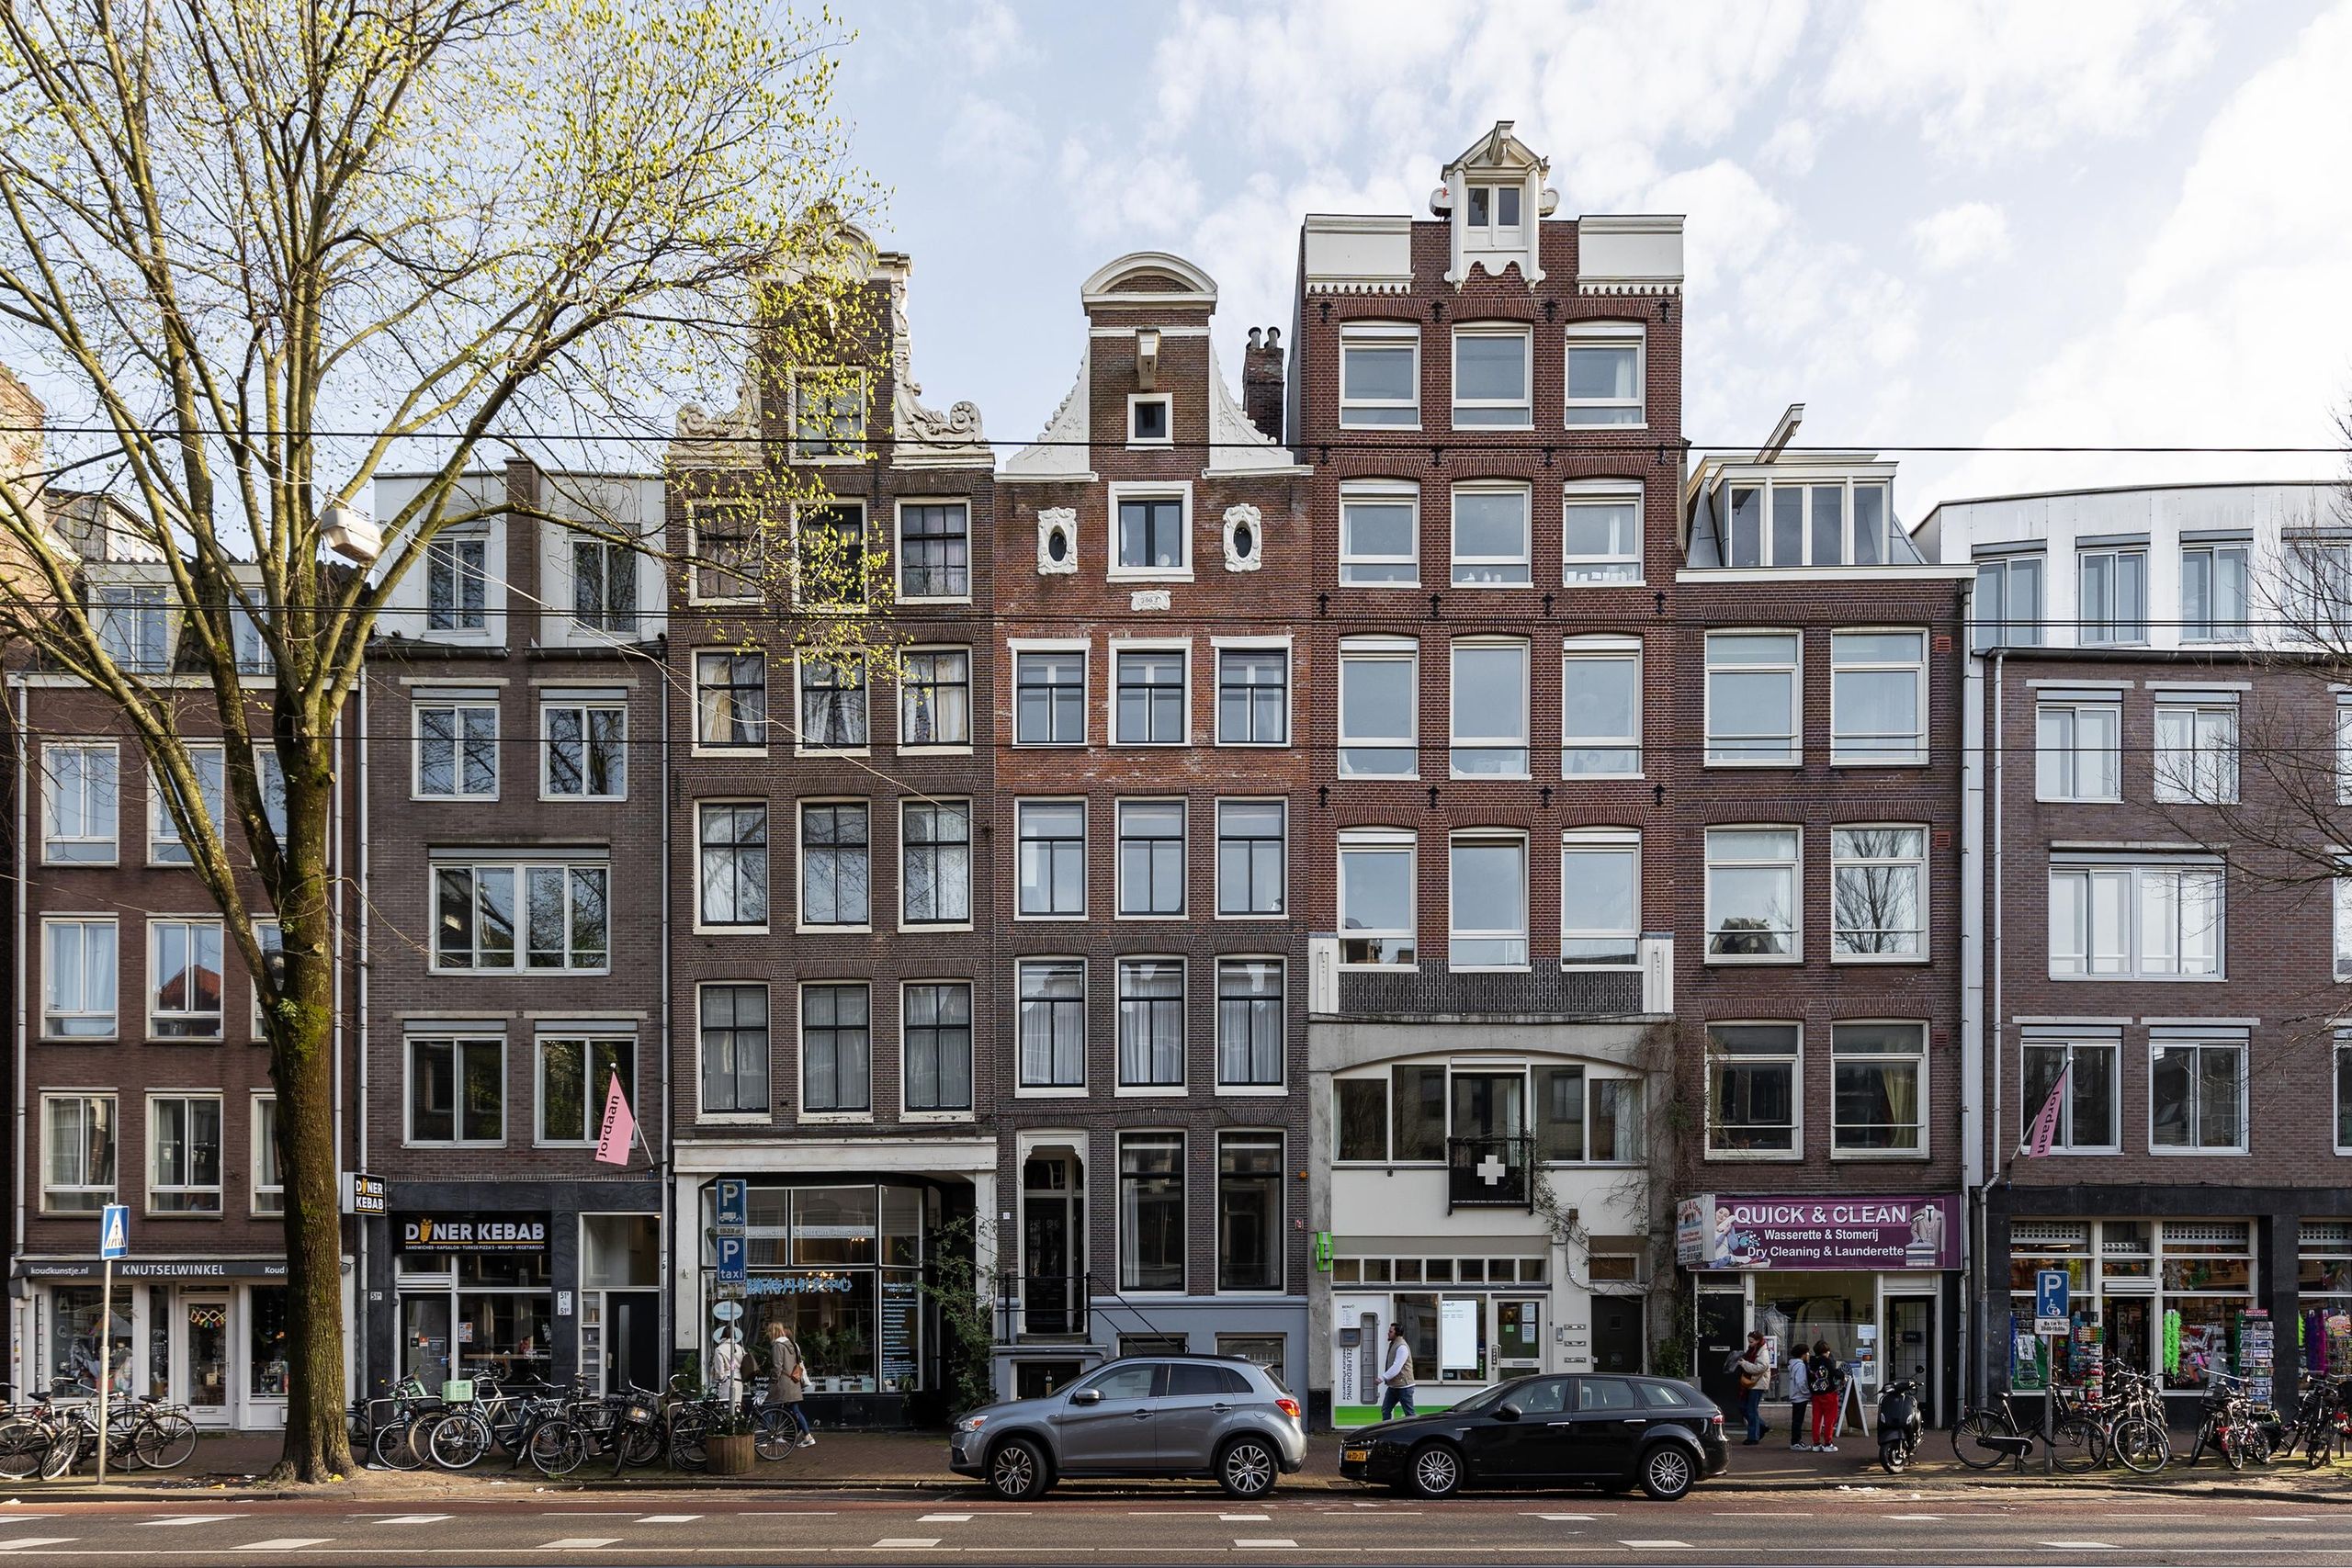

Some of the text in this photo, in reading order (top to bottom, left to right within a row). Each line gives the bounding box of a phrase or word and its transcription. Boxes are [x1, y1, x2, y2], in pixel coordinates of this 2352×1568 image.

[598, 1095, 619, 1158] Jordaan
[722, 1184, 739, 1206] P
[356, 1196, 384, 1210] KEBAB
[1735, 1205, 1906, 1224] QUICK & CLEAN
[478, 1224, 544, 1240] KEBAB
[1764, 1229, 1879, 1242] Wasserette & Stomerij
[723, 1240, 739, 1263] P
[1747, 1246, 1905, 1258] Dry Cleaning & Launderette
[30, 1266, 89, 1276] koudkunstje.nl
[121, 1265, 225, 1275] KNUTSELWINKEL
[265, 1266, 285, 1275] Koud
[720, 1269, 743, 1279] taxi
[2044, 1274, 2062, 1298] P
